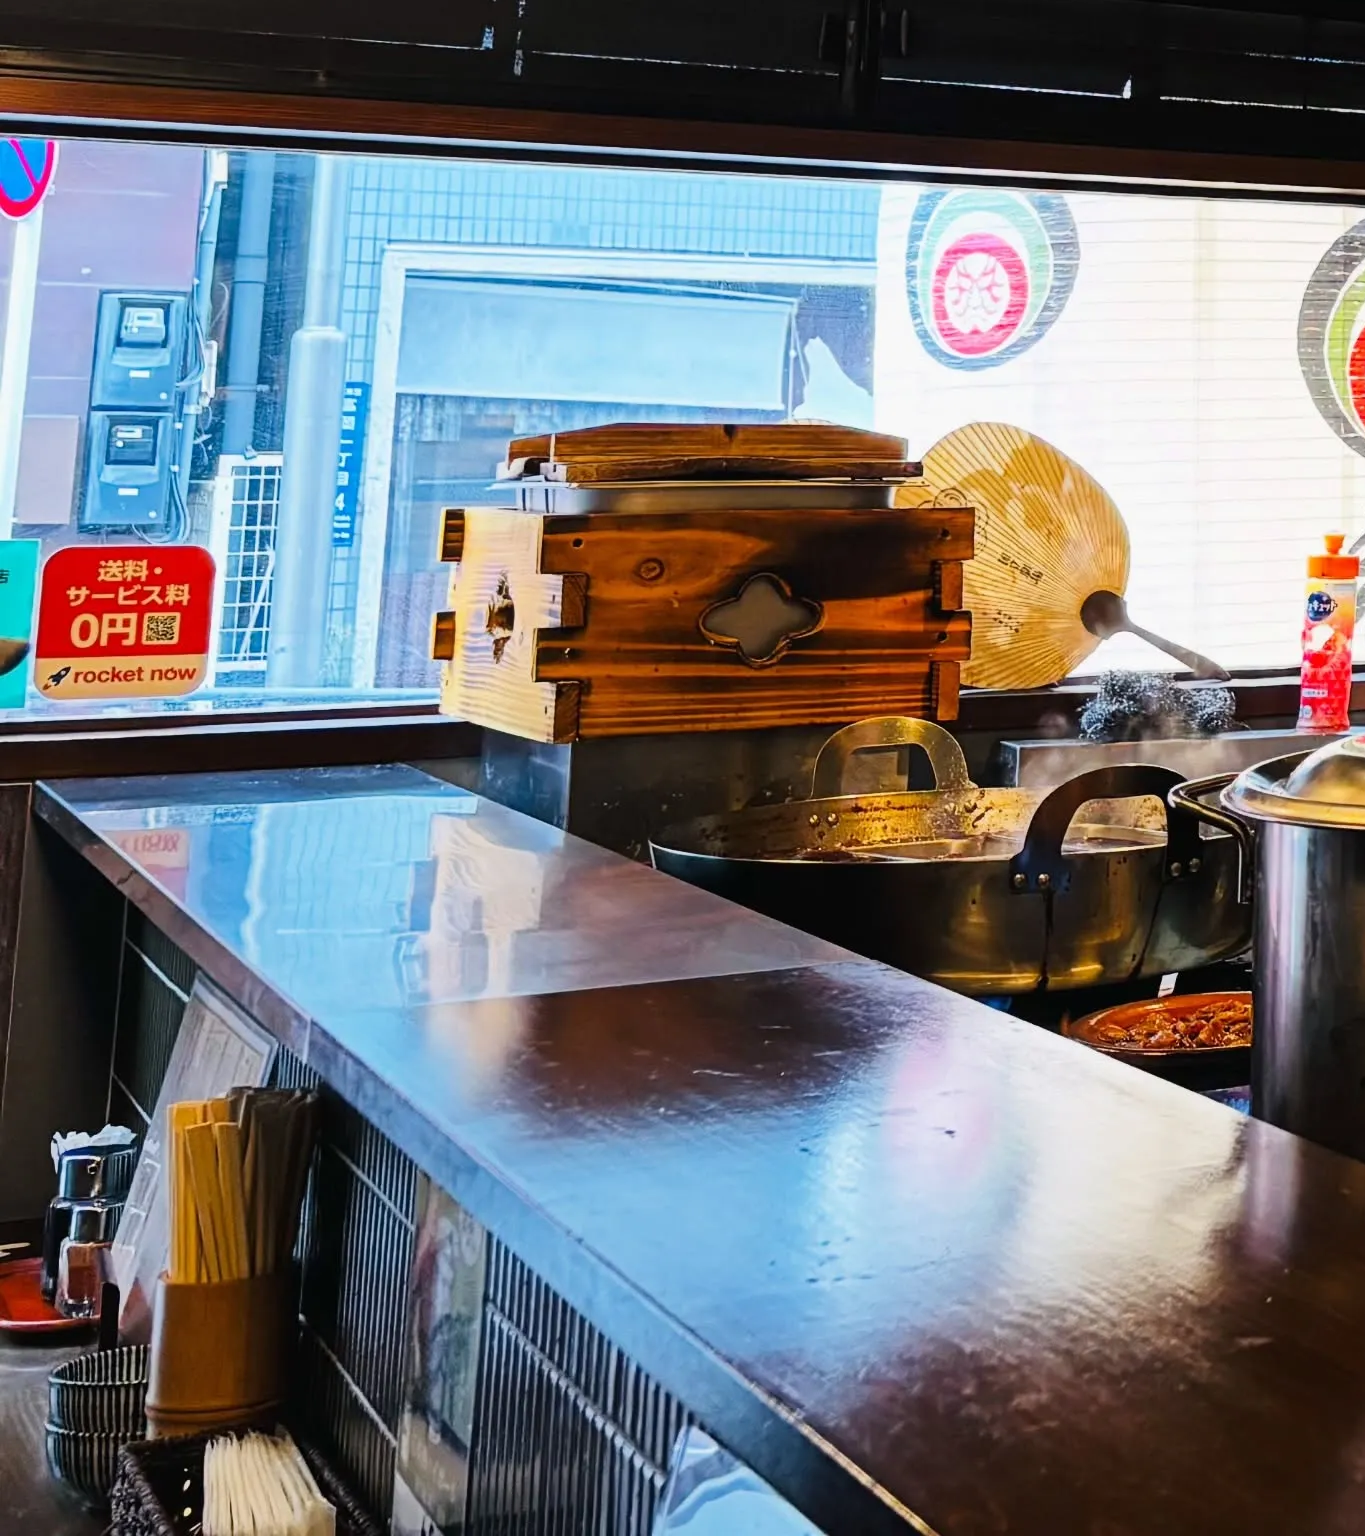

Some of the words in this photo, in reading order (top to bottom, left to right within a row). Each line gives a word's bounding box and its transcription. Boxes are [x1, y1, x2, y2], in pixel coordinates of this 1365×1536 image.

[66, 583, 191, 607] サービス料
[70, 612, 139, 649] 0円
[73, 666, 145, 684] rocket
[150, 667, 197, 681] now
